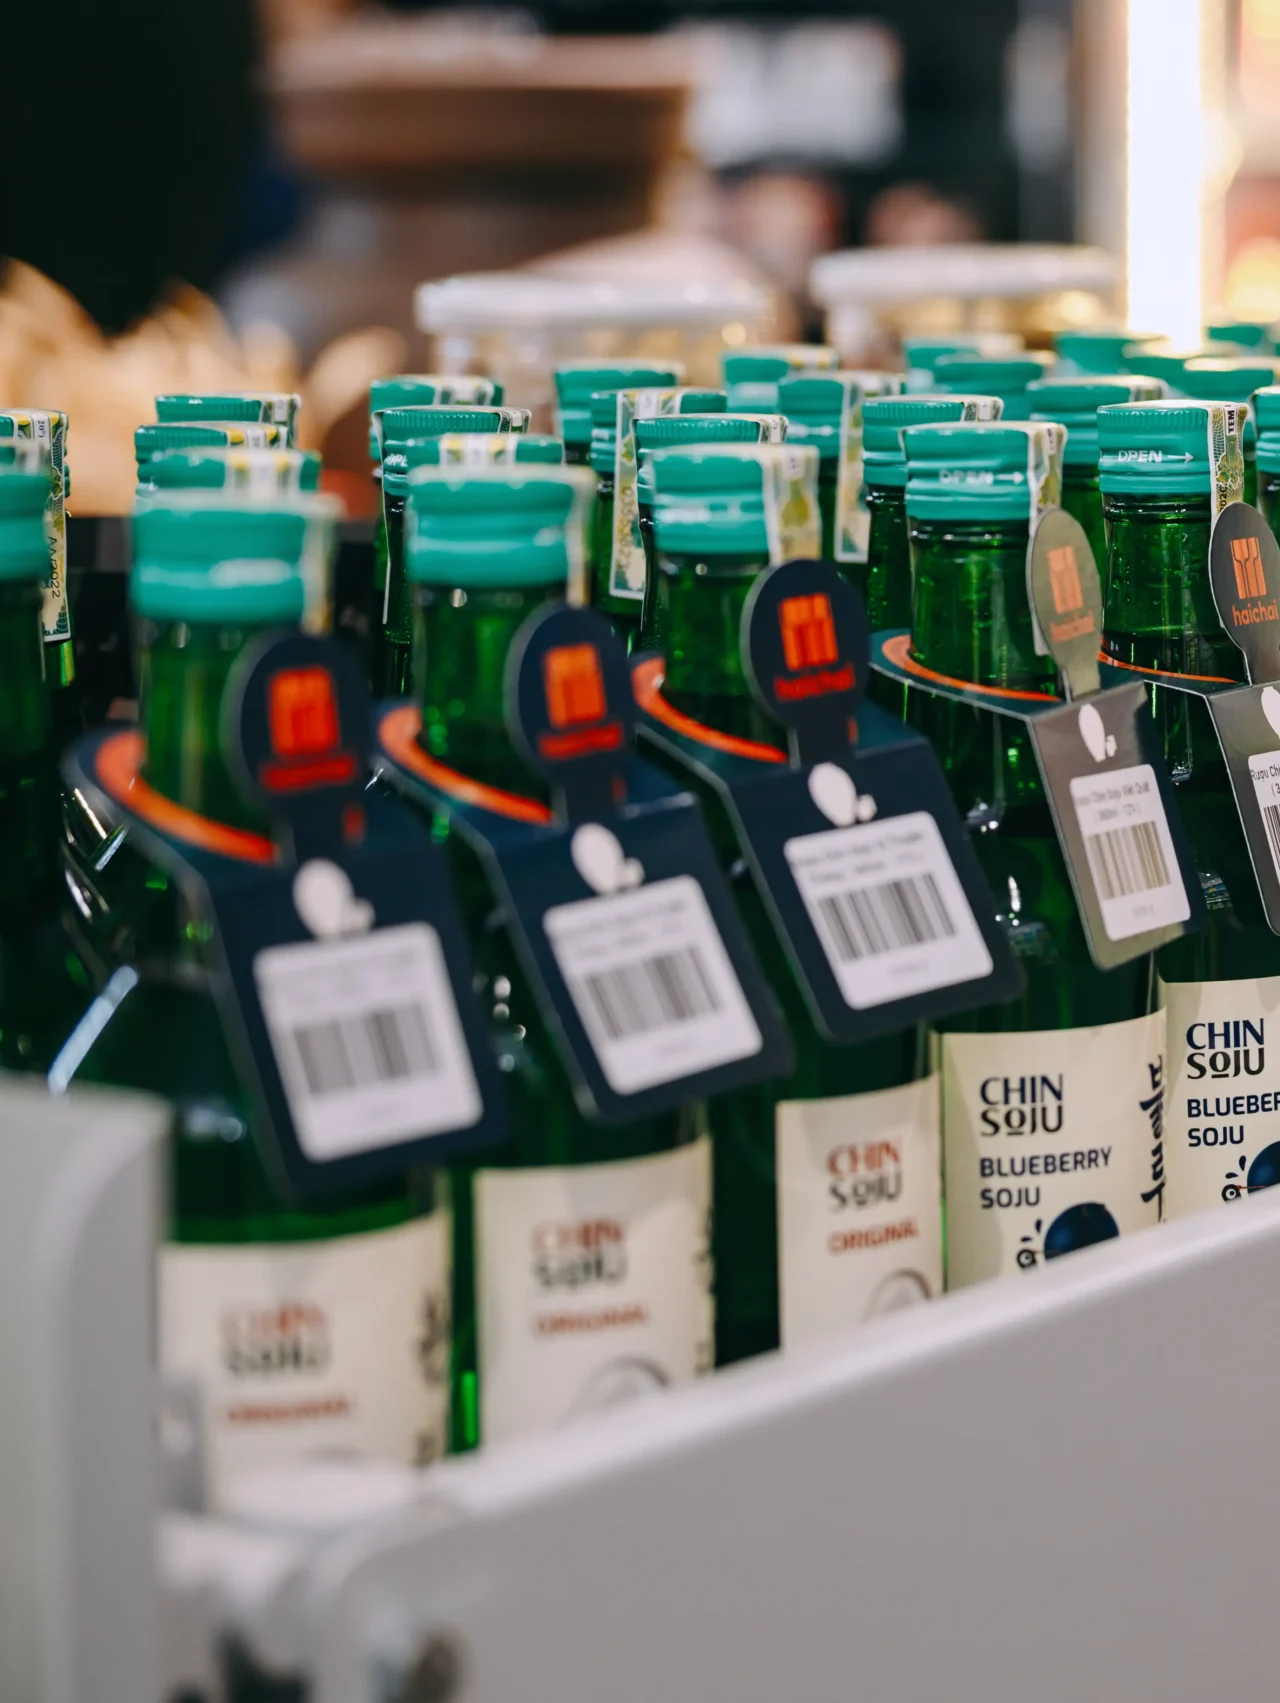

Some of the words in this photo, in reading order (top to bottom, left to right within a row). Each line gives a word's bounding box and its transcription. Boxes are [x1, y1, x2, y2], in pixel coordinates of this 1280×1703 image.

[1227, 409, 1236, 434] TEM
[1117, 450, 1163, 463] OPEN
[1231, 599, 1279, 627] haichai
[1186, 1018, 1265, 1050] CHIN
[1187, 1047, 1265, 1080] SOJU
[980, 1074, 1063, 1105] CHIN
[980, 1105, 1063, 1137] SOJU
[1188, 1125, 1244, 1147] SOJU
[980, 1146, 1112, 1178] BLUEBERRY
[980, 1187, 1040, 1209] SOJU
